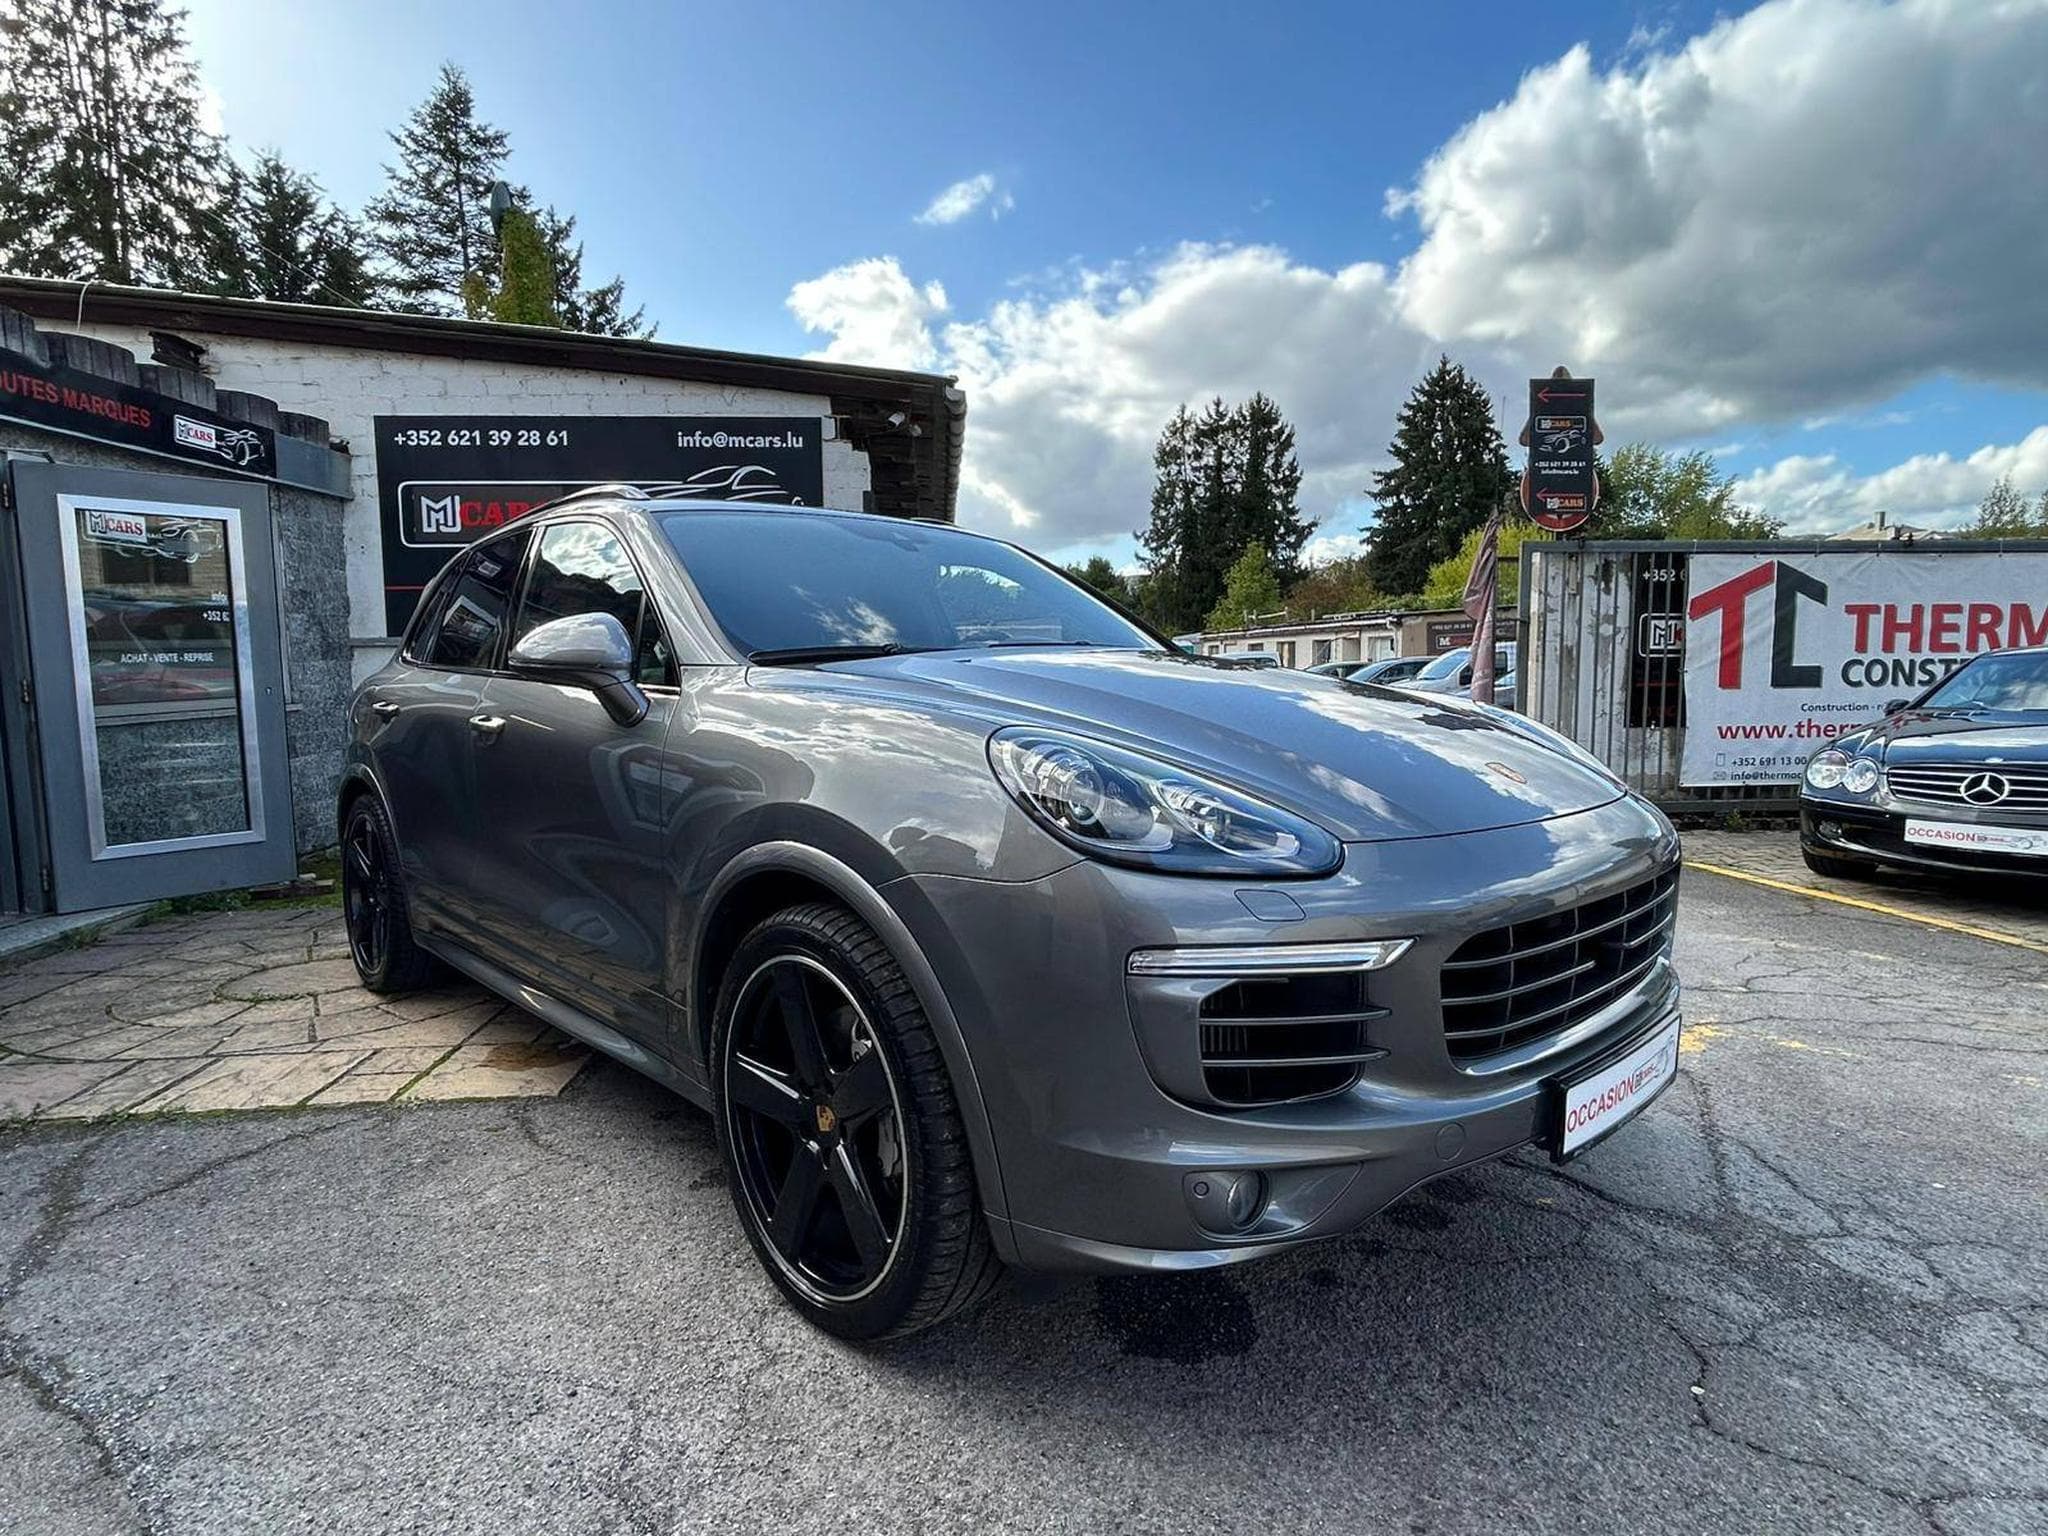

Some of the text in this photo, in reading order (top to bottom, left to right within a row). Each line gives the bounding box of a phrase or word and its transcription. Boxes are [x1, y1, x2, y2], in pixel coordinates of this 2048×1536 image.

[0, 370, 151, 428] UTES MARQUES
[394, 430, 568, 446] +352 621 39 28 61
[677, 431, 803, 448] info@mcars.lu
[120, 653, 147, 663] ACHAT
[154, 653, 179, 663] VENTE
[183, 652, 214, 662] REPRISE
[1841, 658, 1972, 688] CONST
[1800, 703, 1869, 712] Construction
[1717, 718, 1862, 740] www.ther
[1731, 756, 1756, 767] +352
[1759, 756, 1777, 767] 691
[1780, 756, 1792, 766] 13
[1907, 827, 1976, 842] OCCASION
[1566, 1074, 1636, 1133] OCCASION
